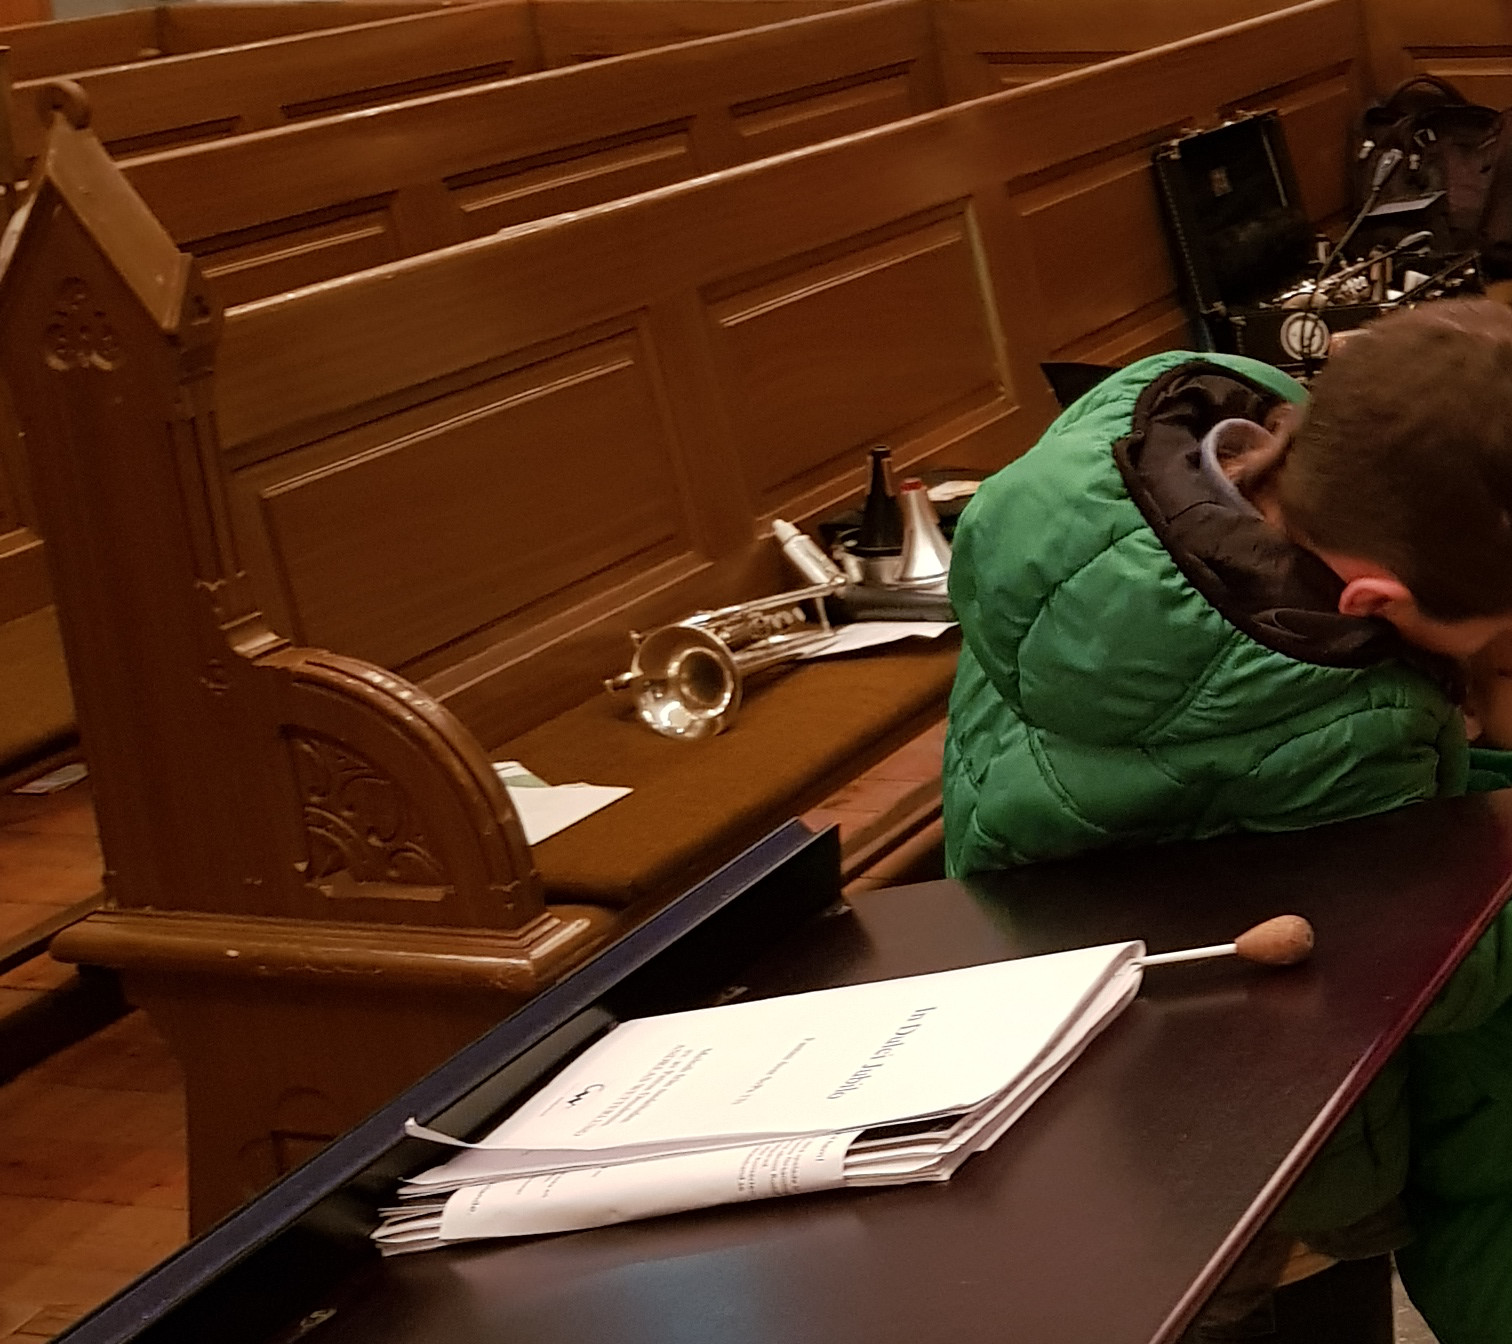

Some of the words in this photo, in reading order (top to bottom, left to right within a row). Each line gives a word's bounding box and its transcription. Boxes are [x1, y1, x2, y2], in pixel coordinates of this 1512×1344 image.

[906, 1006, 938, 1022] In
[869, 1023, 922, 1060] Dulci
[826, 1063, 884, 1100] Jubilo
